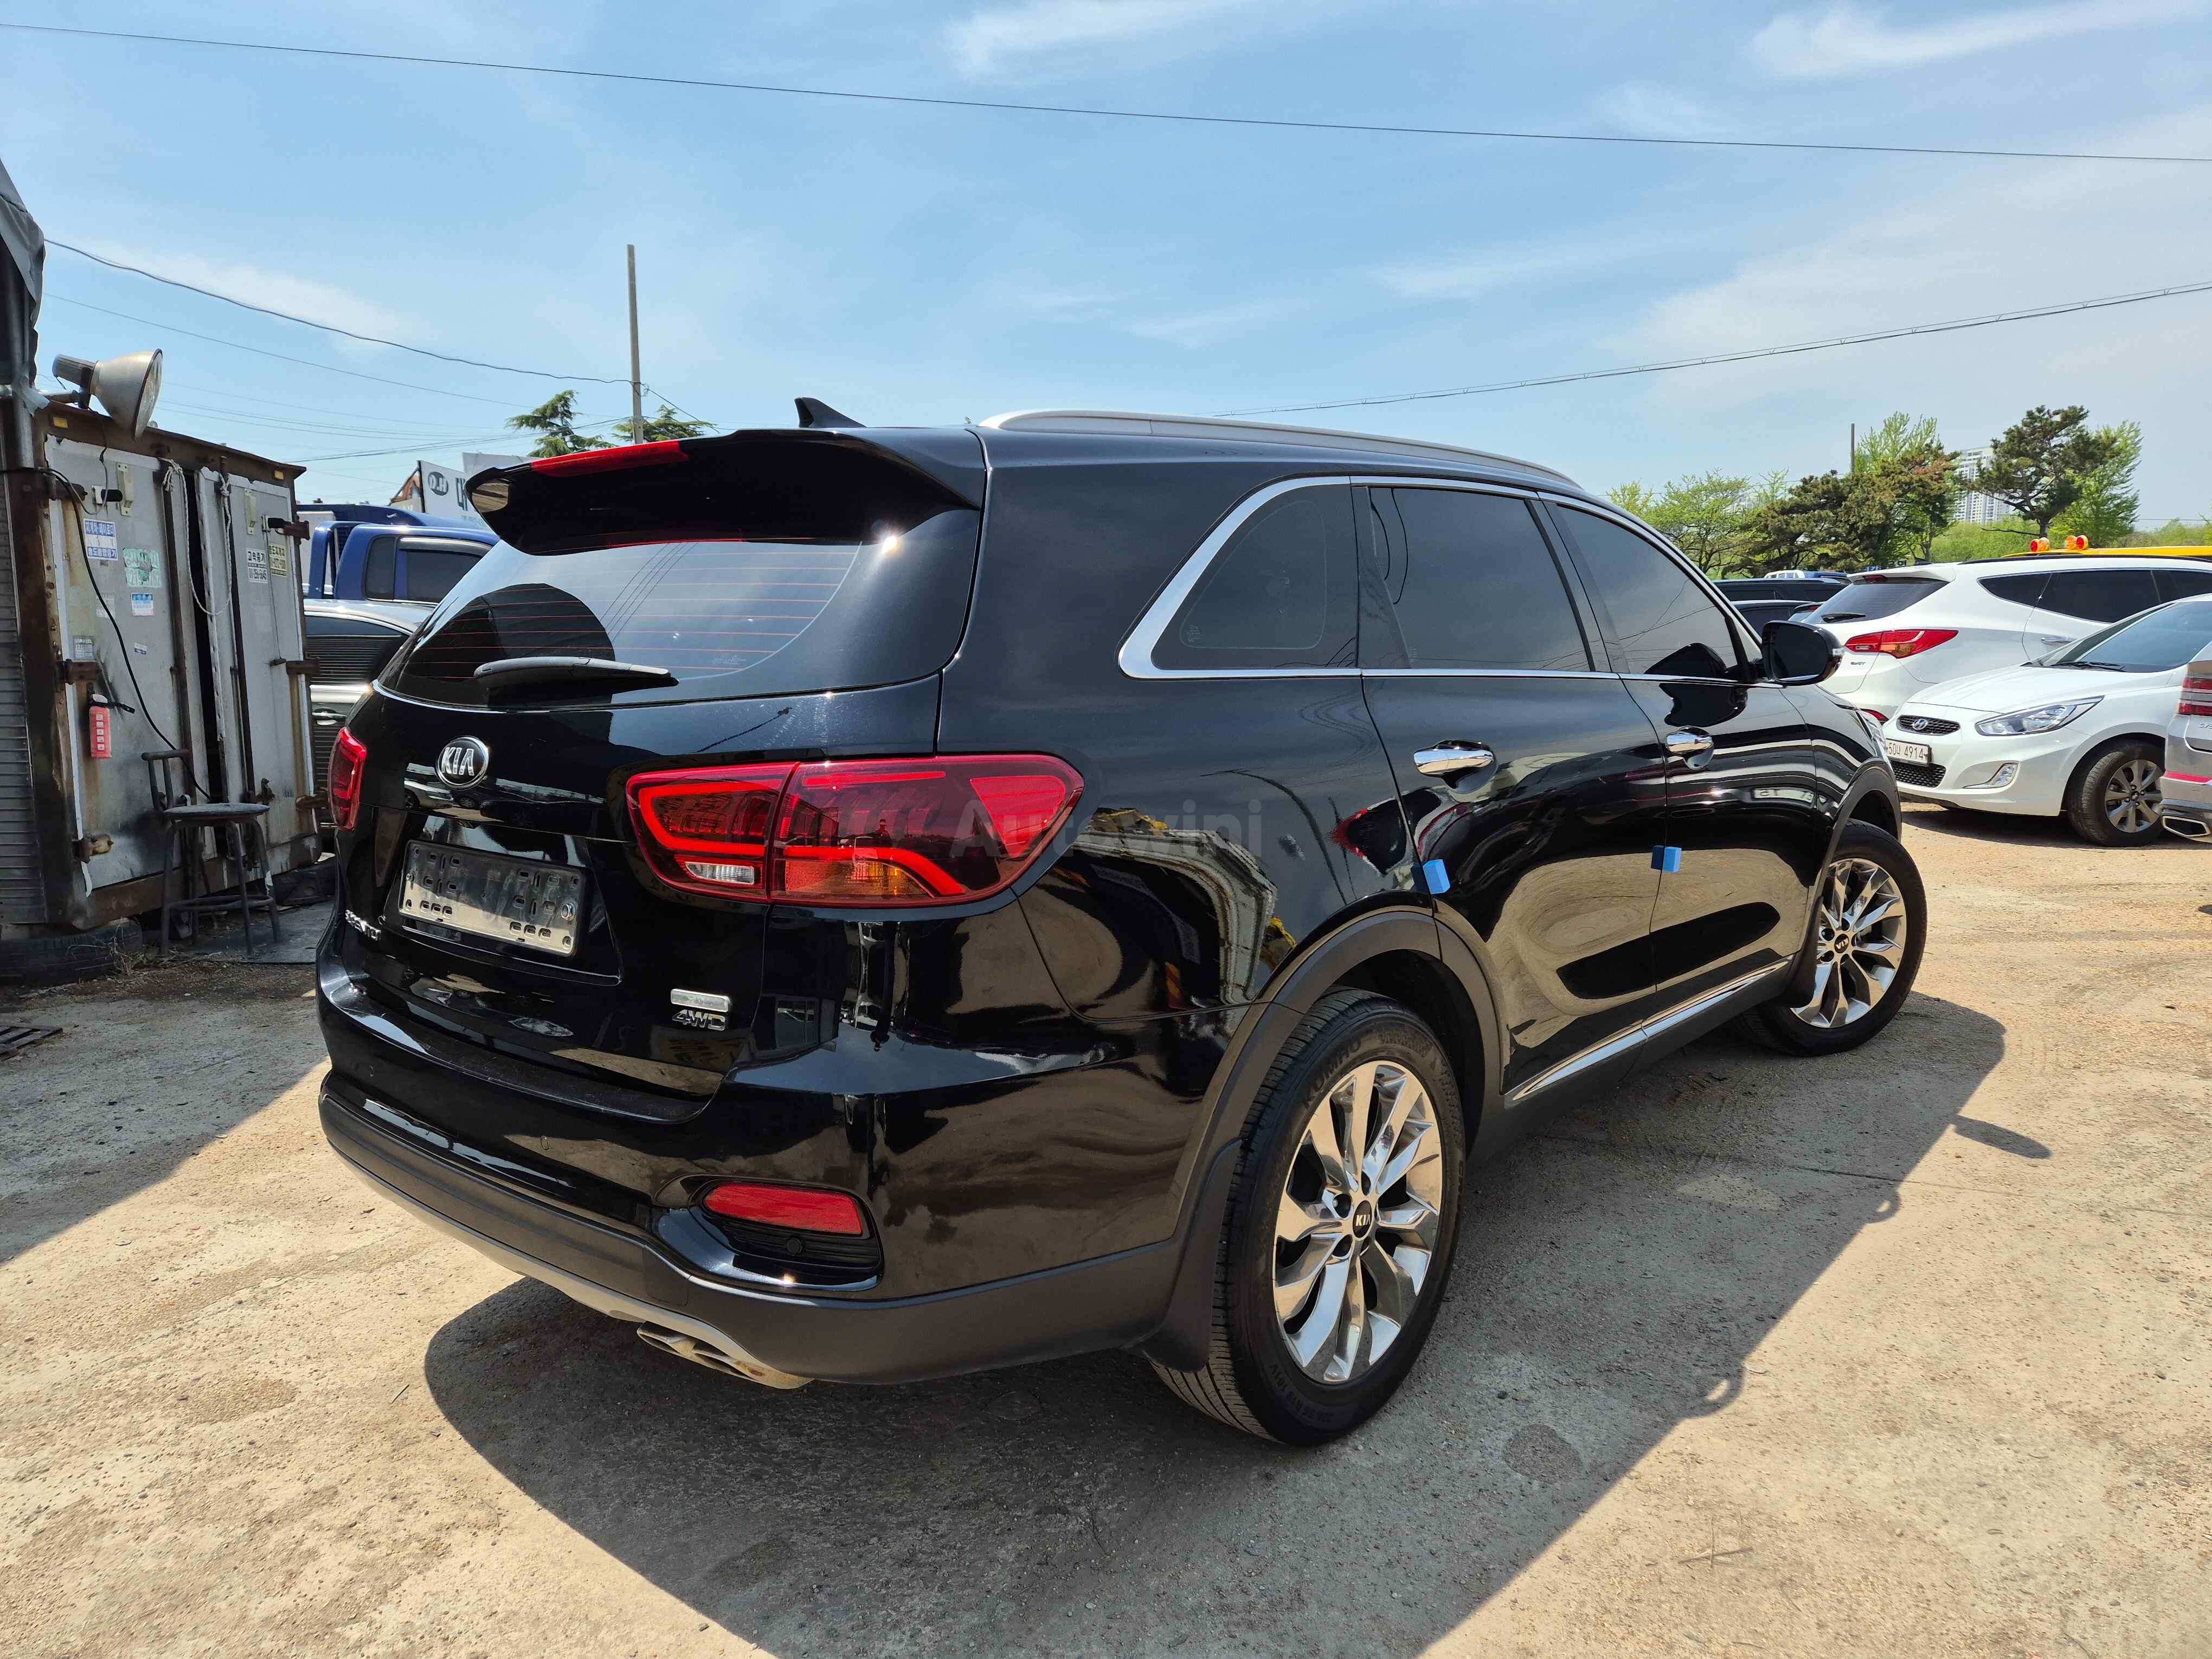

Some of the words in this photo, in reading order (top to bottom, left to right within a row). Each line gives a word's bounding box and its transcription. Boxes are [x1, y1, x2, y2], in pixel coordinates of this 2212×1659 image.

[428, 474, 447, 493] D.H
[441, 747, 475, 776] KIA
[1904, 745, 1924, 761] 4914
[672, 1009, 725, 1031] 4WD
[1355, 1214, 1371, 1226] KIA
